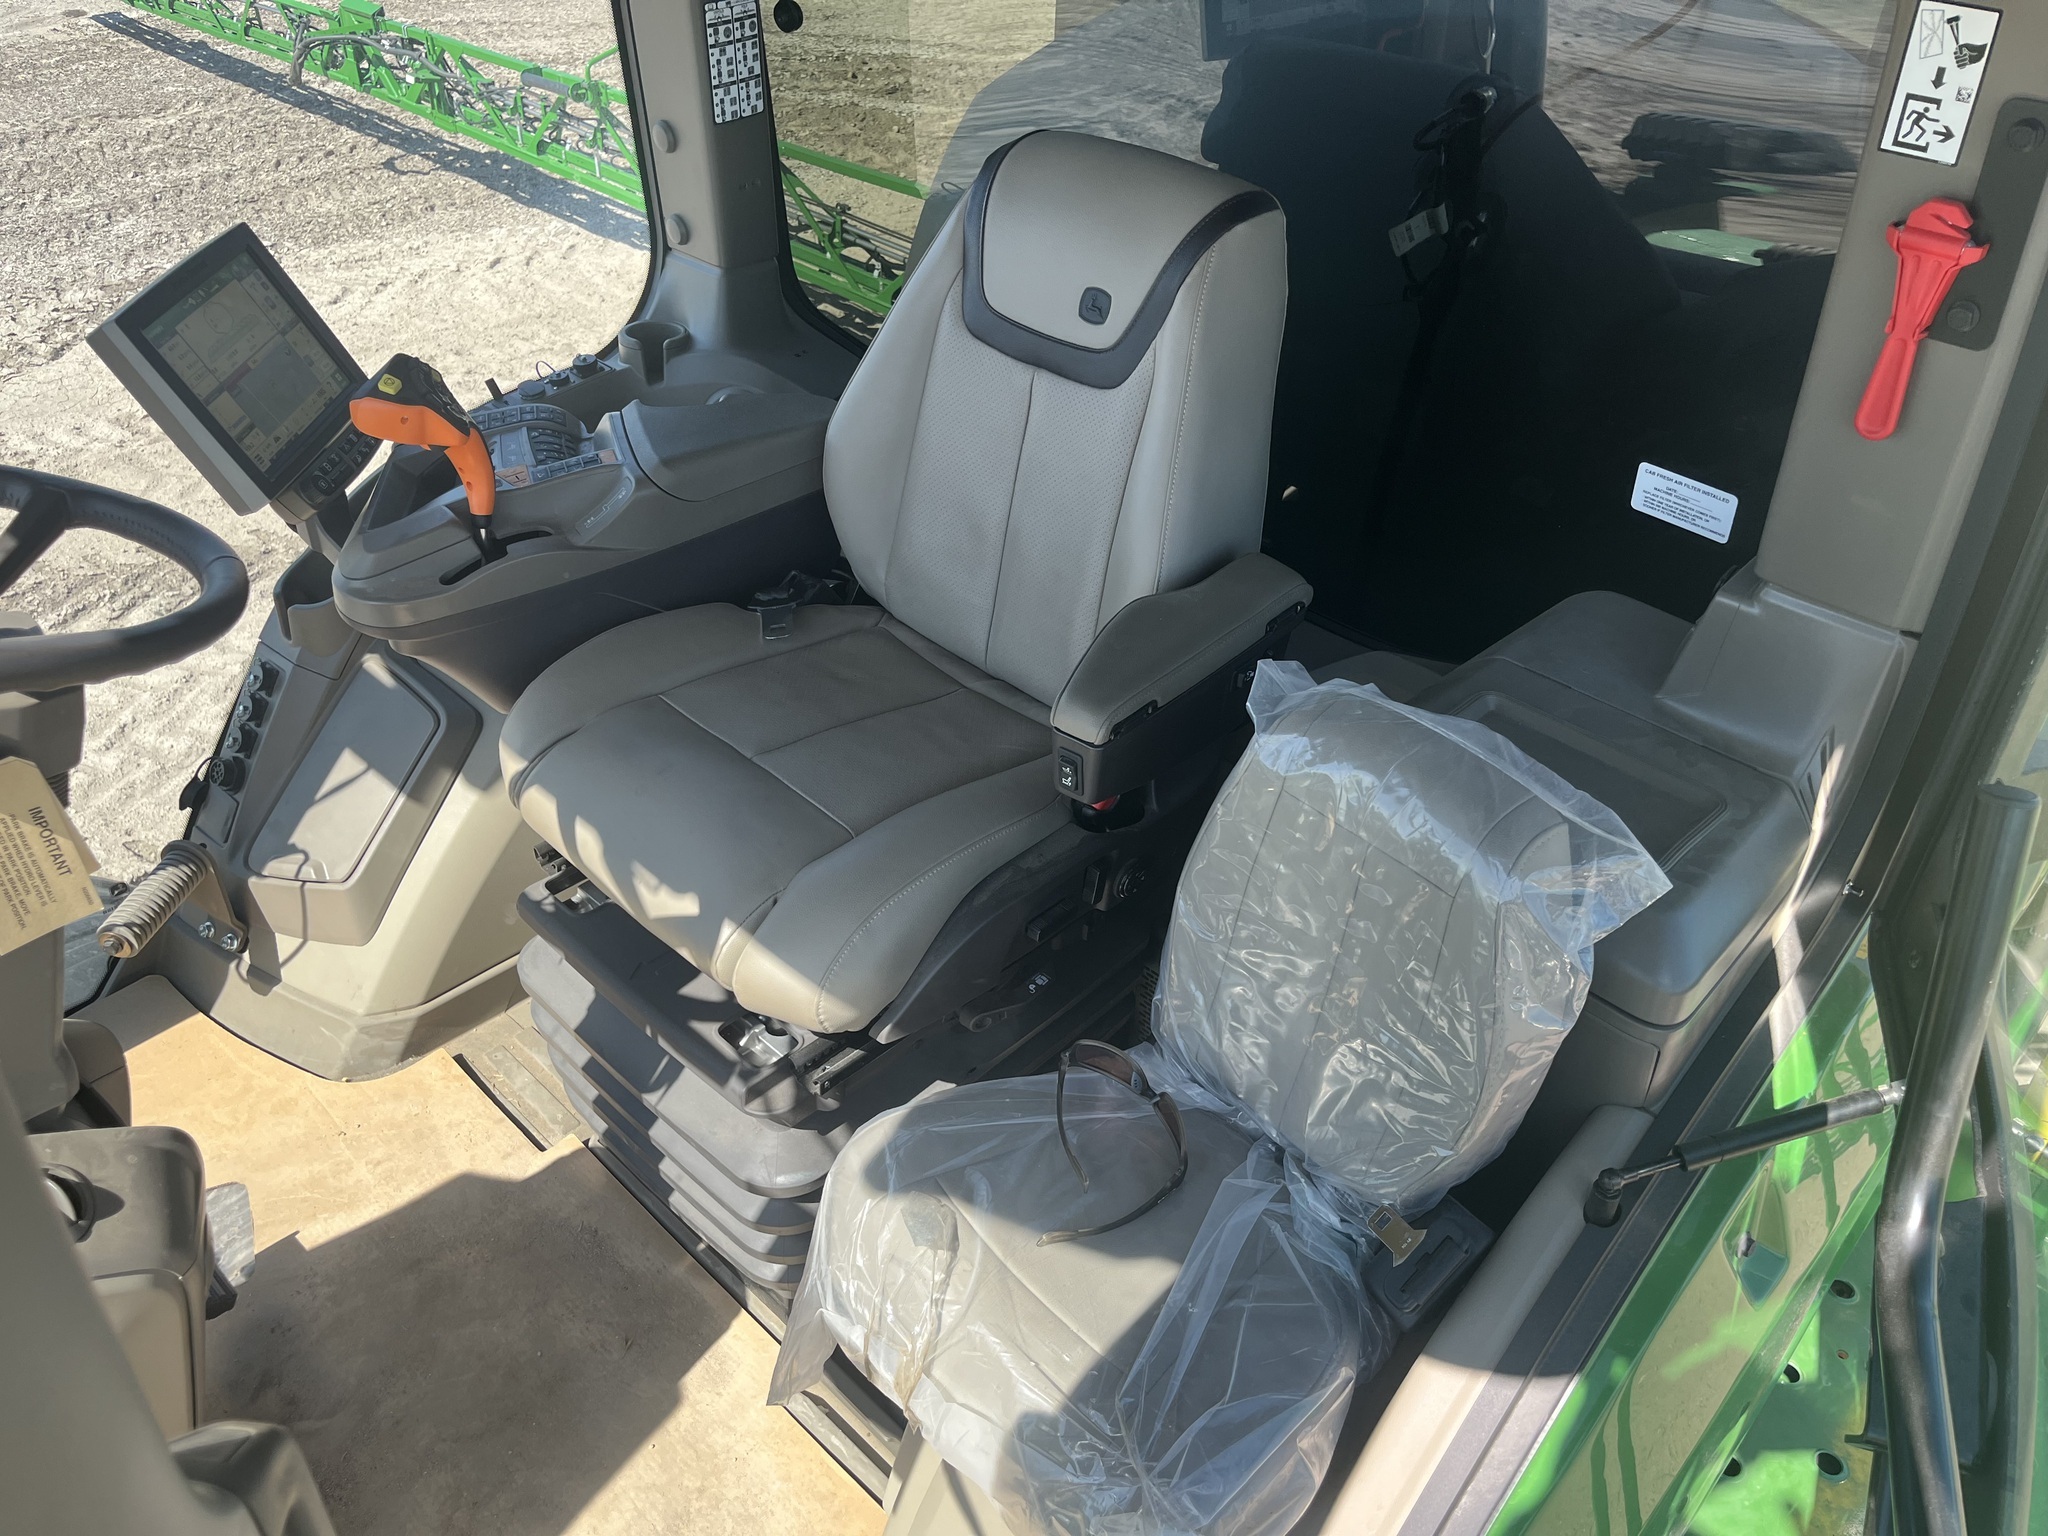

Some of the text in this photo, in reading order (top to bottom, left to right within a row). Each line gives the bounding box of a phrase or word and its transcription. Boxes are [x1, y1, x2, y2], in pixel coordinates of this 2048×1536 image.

[1657, 473, 1673, 482] FRESH
[1684, 483, 1700, 493] FILTER
[1702, 490, 1730, 504] INSTALLED
[0, 818, 16, 842] APPLIED
[12, 842, 26, 860] WHEN
[31, 880, 46, 900] LEVER
[6, 852, 18, 869] PARK
[28, 806, 72, 876] IMPORTANT
[0, 861, 11, 877] PARK
[18, 898, 31, 916] MOVE
[2, 888, 14, 904] PARK
[31, 859, 58, 903] AUTOMATICALLY
